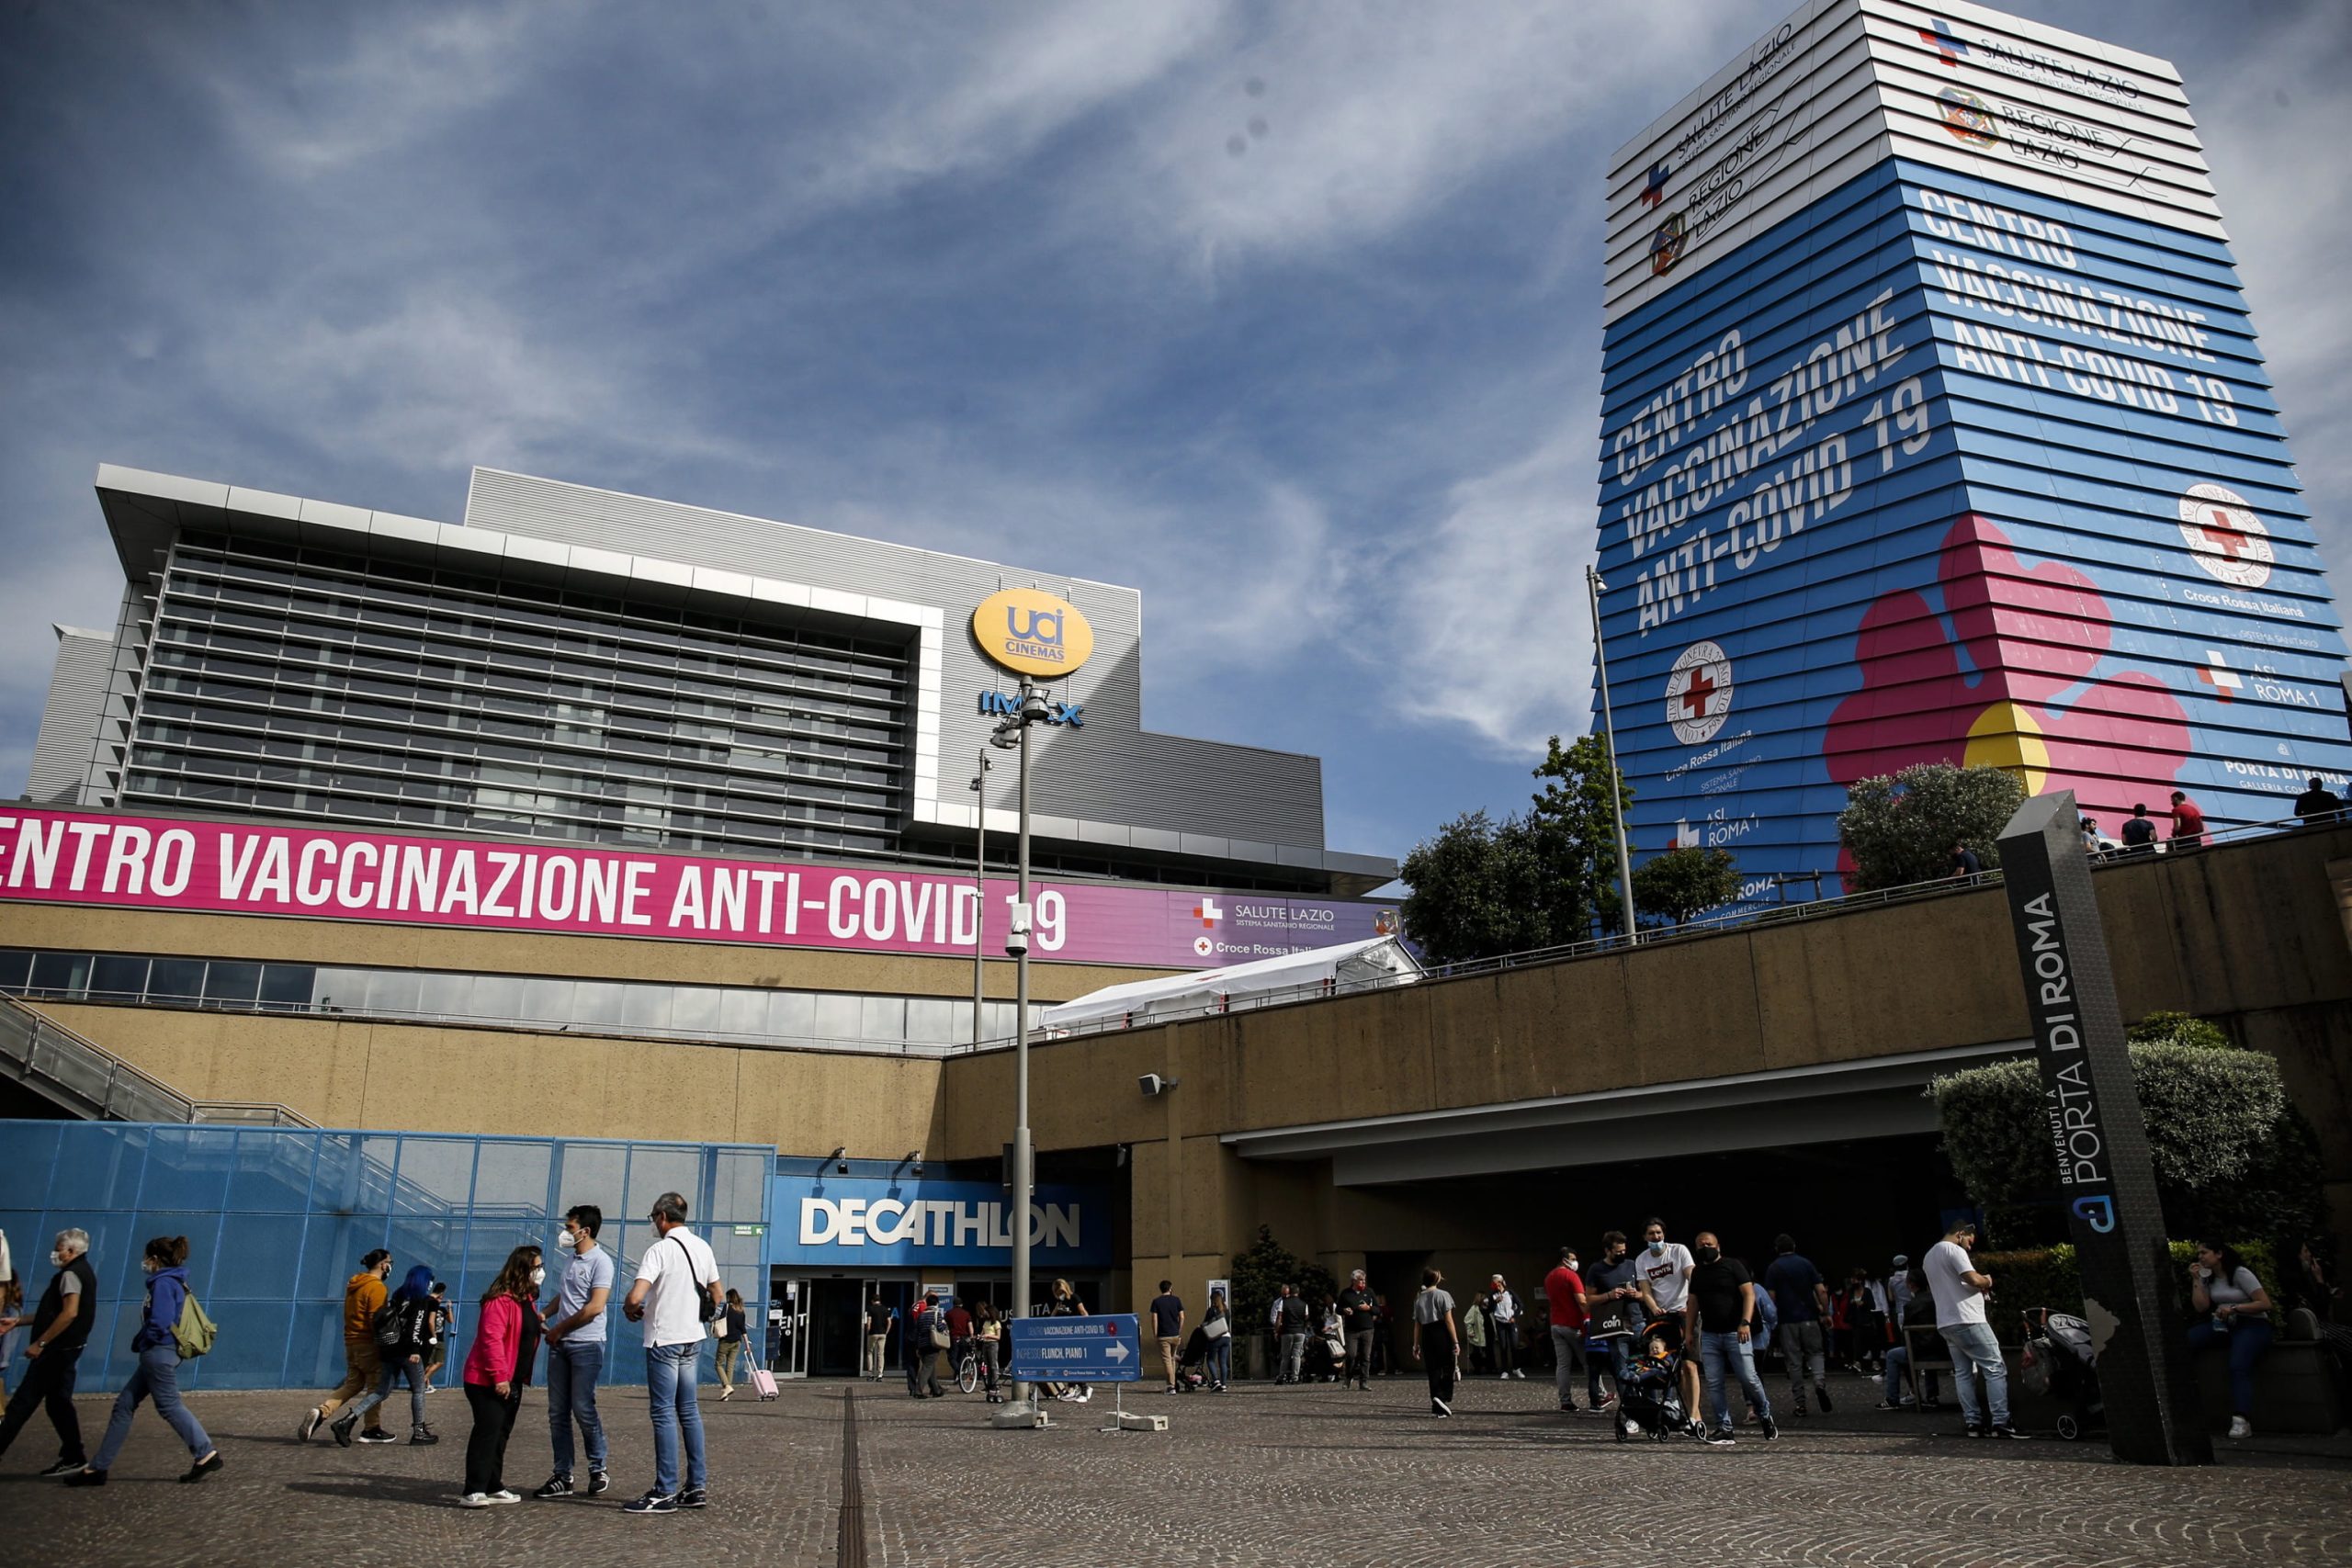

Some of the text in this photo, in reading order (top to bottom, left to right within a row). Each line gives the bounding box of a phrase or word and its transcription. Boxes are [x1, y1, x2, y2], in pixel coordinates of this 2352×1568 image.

[1980, 38, 2142, 99] SALUTE LAZIO
[1676, 23, 1792, 160] SALUTE LAZIO
[2000, 105, 2104, 152] REGIONE
[1689, 124, 1765, 209] REGIONE
[2009, 135, 2079, 170] LAZIO
[1692, 179, 1744, 240] LAZIO
[1919, 188, 2077, 270] CENTRO
[1932, 249, 2217, 364] VACCINAZIONE
[1952, 320, 2239, 426] ANTI-COVID 19
[1613, 329, 1748, 487] CENTRO
[1623, 287, 1908, 559] VACCINAZIONE
[1637, 376, 1931, 638] ANTI-COVID 19
[2183, 589, 2305, 618] Croce Rossa Italiana
[1005, 641, 1065, 660] CINEMAS
[2250, 663, 2281, 684] ASL
[982, 691, 1084, 727] IMX
[2254, 683, 2321, 706] ROMA 1
[1690, 748, 1719, 770] Rossa
[2223, 761, 2349, 785] PORTA DI ROMA
[2239, 780, 2283, 793] GALLERIA
[1706, 807, 1728, 829] ASL
[1709, 819, 1750, 847] ROMA
[220, 832, 657, 927] VACCINAZIONE
[668, 863, 980, 946] ANTI-COVID
[1235, 905, 1335, 922] SALUTE LAZIO
[1236, 919, 1335, 931] SISTEMA SANITARIO REGIONALE
[1216, 942, 1250, 954] Croce
[1253, 943, 1289, 955] Rossa
[2024, 891, 2108, 1185] PORTA DI ROMA
[2046, 1089, 2073, 1185] BENVENUTI A
[798, 1197, 1080, 1247] DECATHLON
[999, 1303, 1051, 1323] USITA
[1602, 1314, 1622, 1329] coin
[1065, 1348, 1083, 1359] PIANO
[1083, 1348, 1088, 1359] 1
